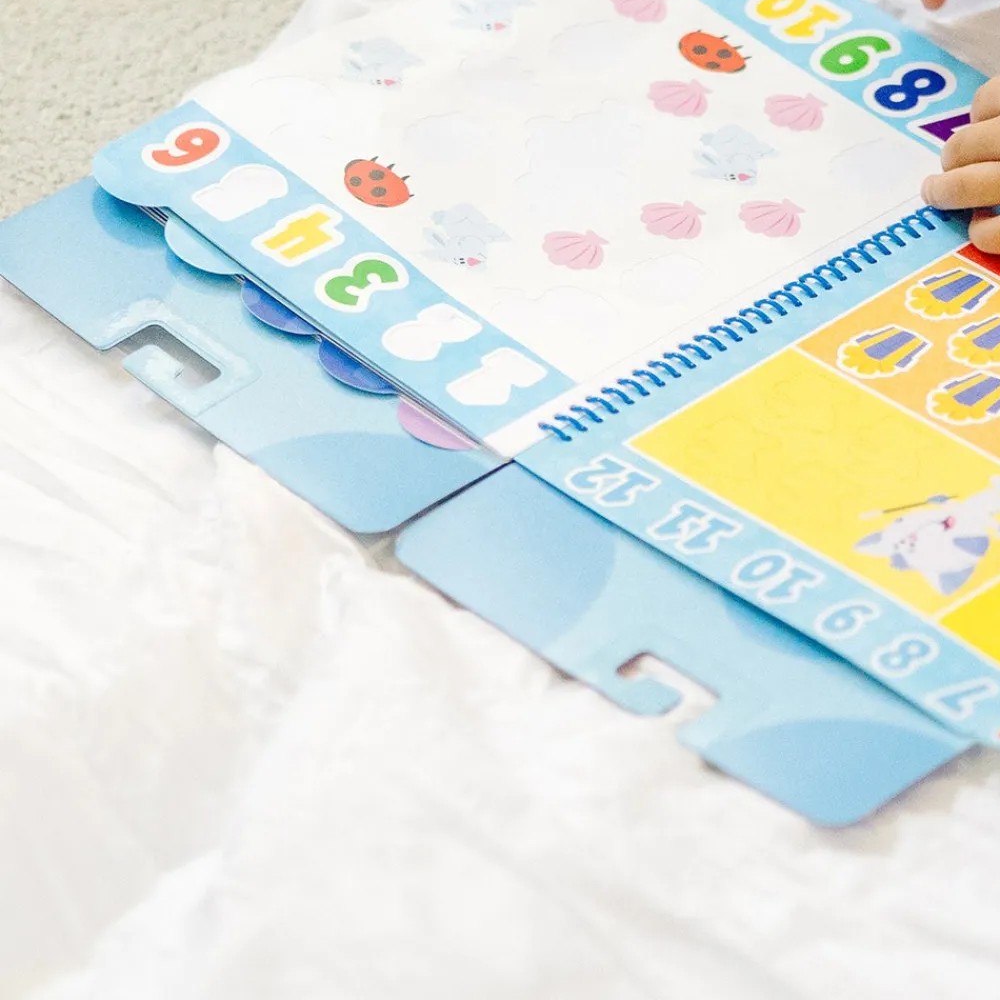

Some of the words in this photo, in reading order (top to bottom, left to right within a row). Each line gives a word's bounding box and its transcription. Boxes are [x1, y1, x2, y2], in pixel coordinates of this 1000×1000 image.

[818, 33, 894, 77] 9
[872, 67, 948, 113] 8
[149, 126, 222, 168] 6
[259, 208, 336, 262] 4
[322, 257, 400, 308] 3
[566, 455, 657, 504] 12
[650, 502, 740, 551] 11
[732, 551, 821, 600] 10
[817, 602, 877, 638] 9
[875, 636, 935, 675] 8
[932, 680, 994, 717] 7
